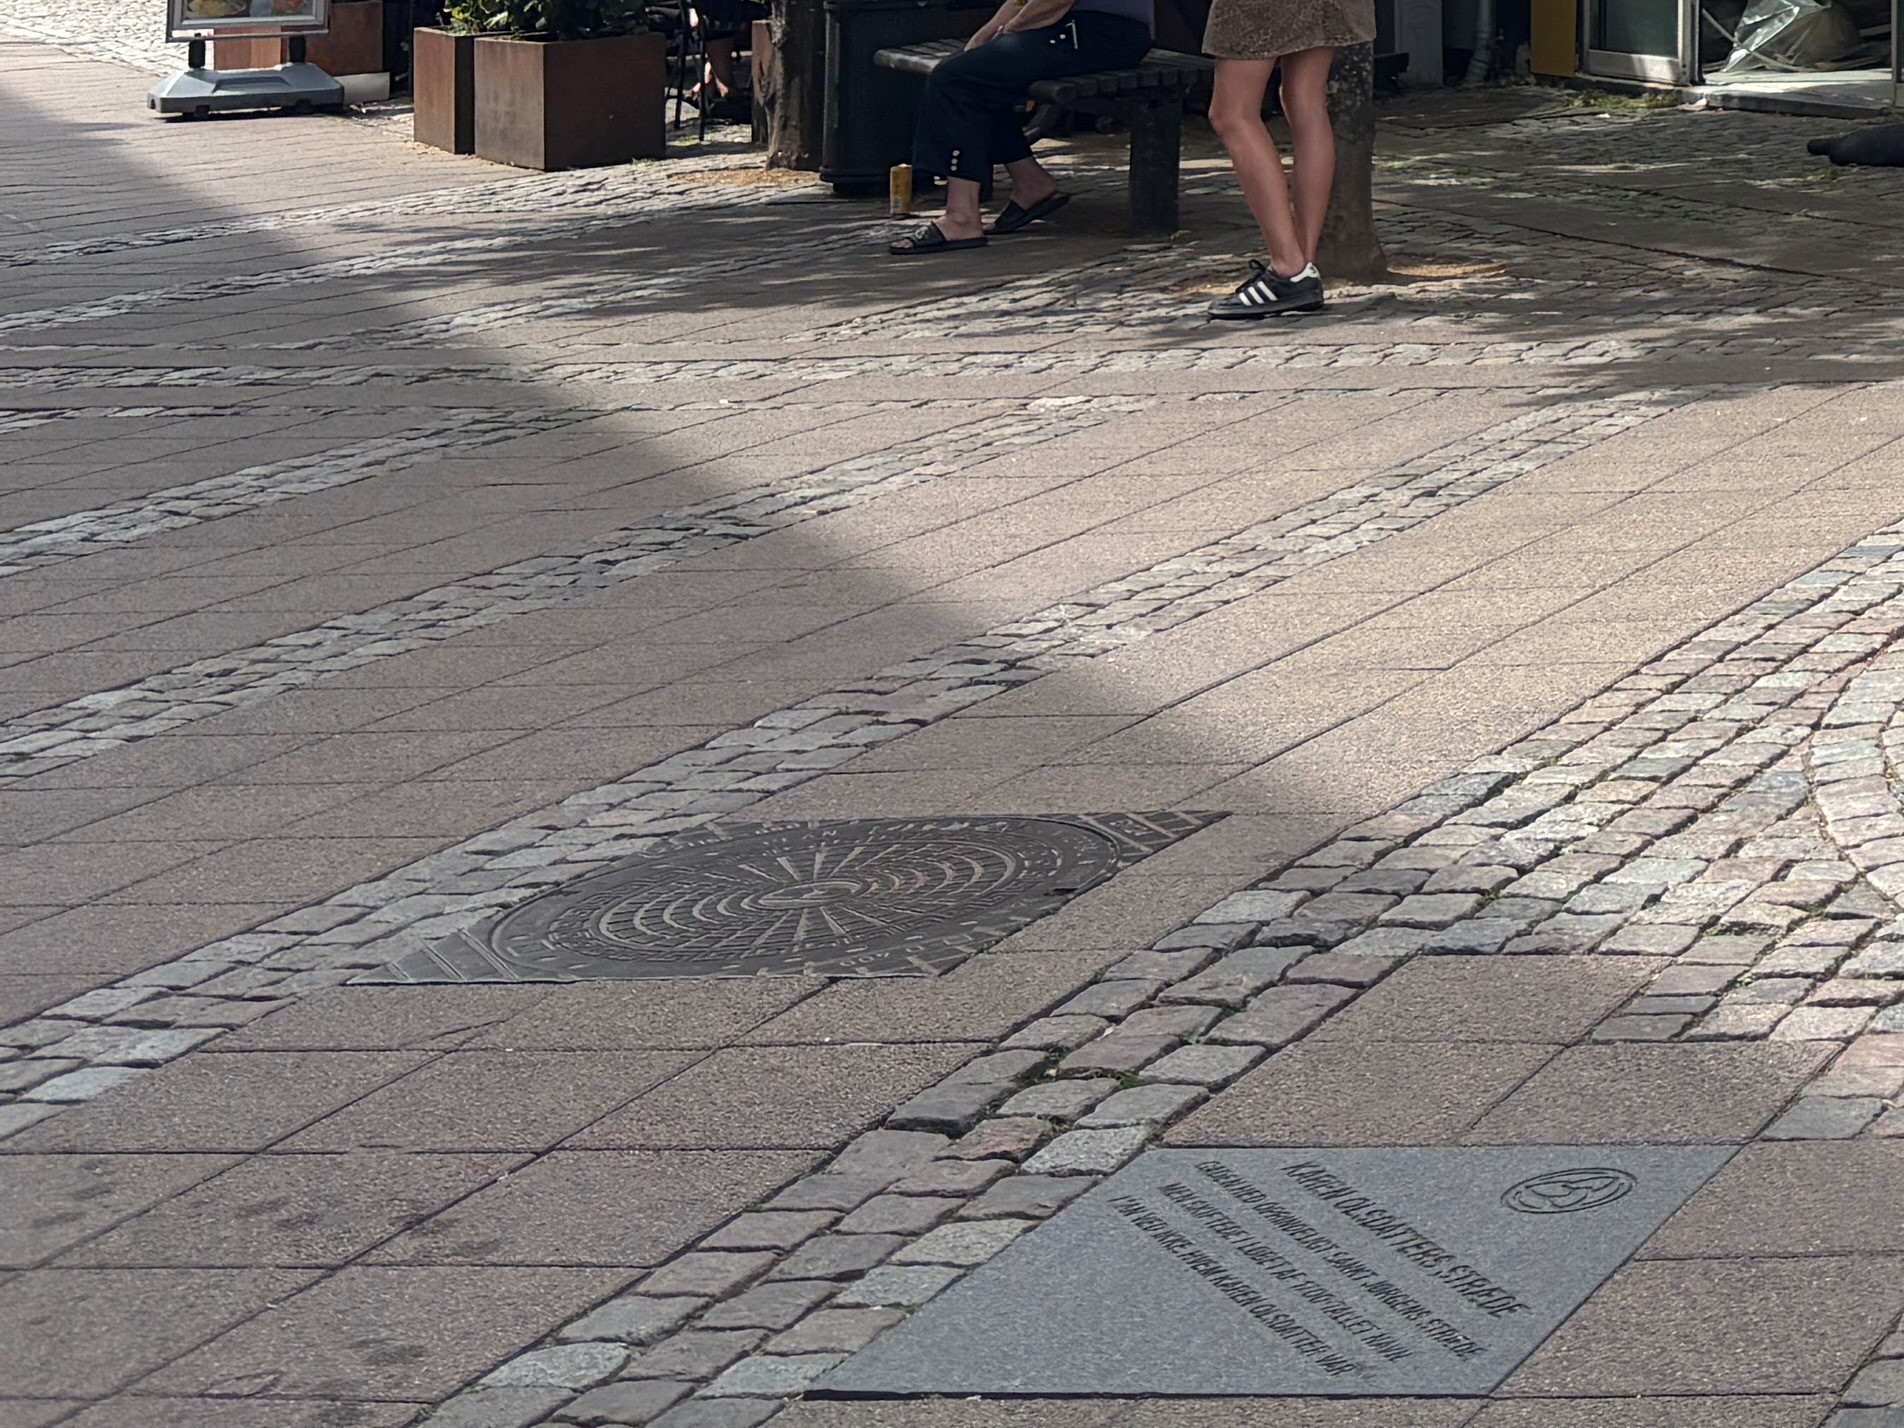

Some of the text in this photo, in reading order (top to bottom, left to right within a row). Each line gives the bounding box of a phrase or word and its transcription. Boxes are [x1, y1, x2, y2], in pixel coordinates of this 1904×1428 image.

[1279, 1161, 1531, 1319] KAREN OLSDATTERS STRÆDE
